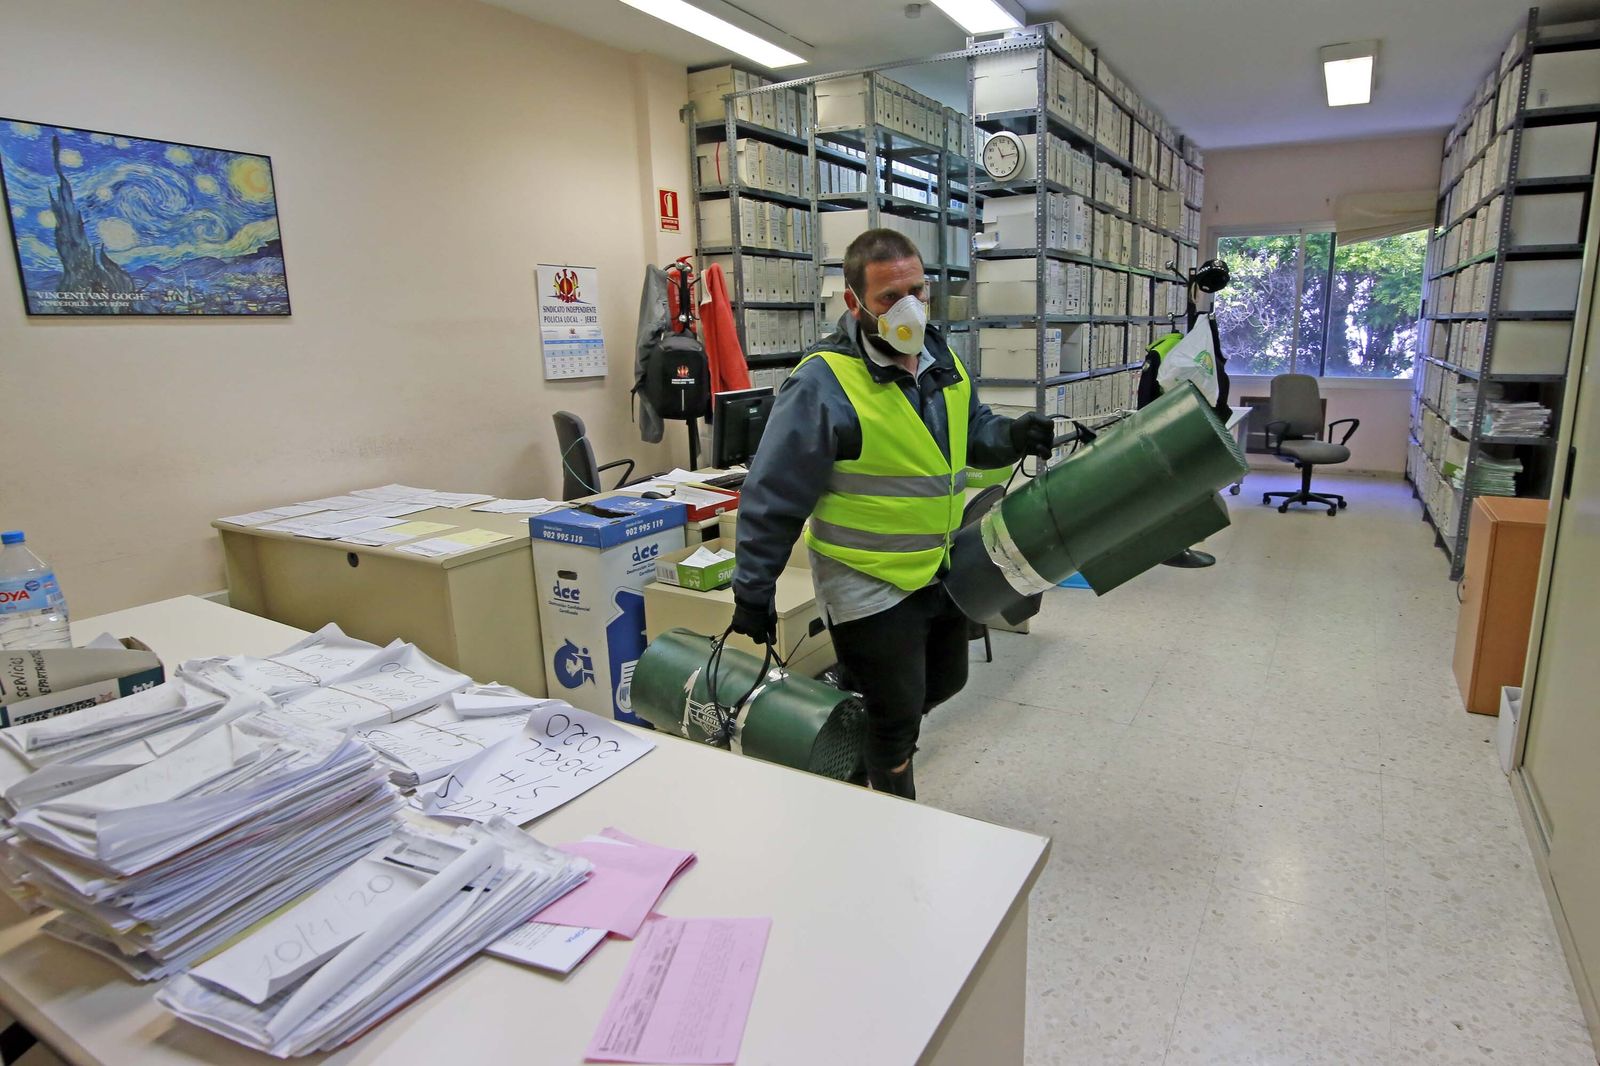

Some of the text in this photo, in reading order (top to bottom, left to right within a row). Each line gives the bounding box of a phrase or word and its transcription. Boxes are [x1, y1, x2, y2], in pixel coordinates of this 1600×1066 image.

[35, 291, 145, 301] VINCENT VAN GOGH
[542, 530, 556, 540] 902
[556, 532, 569, 541] 995
[625, 527, 638, 537] 902
[638, 522, 651, 533] 995
[652, 519, 664, 529] 119
[632, 543, 659, 562] dcc
[552, 580, 581, 600] dcc
[379, 662, 440, 688] 2020
[545, 713, 622, 758] 2020
[516, 737, 604, 777] ABRIL
[487, 769, 561, 801] S/H
